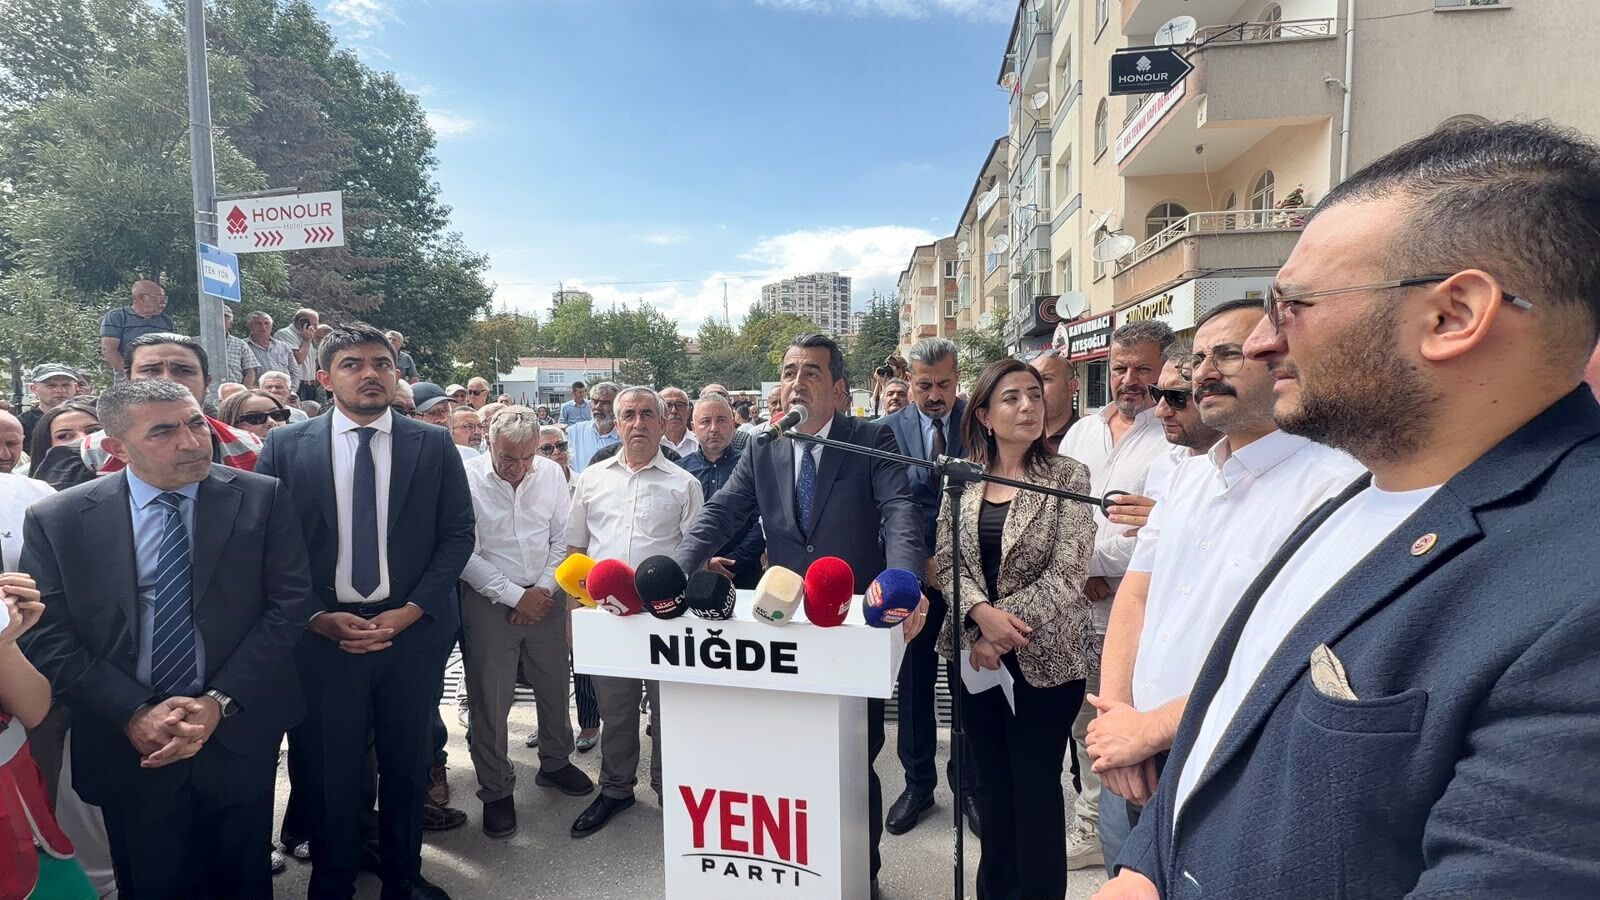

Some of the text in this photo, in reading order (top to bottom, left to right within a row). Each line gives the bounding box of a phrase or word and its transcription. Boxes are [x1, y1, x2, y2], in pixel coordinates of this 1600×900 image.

[1118, 72, 1169, 84] HONOUR
[252, 202, 332, 223] HONOUR
[204, 264, 229, 279] TEK YÖN
[1144, 294, 1173, 320] OPTİK
[1068, 315, 1110, 338] KAVURMACI
[1071, 333, 1107, 353] ATEŞOĞLU
[649, 627, 799, 675] NİĞDE
